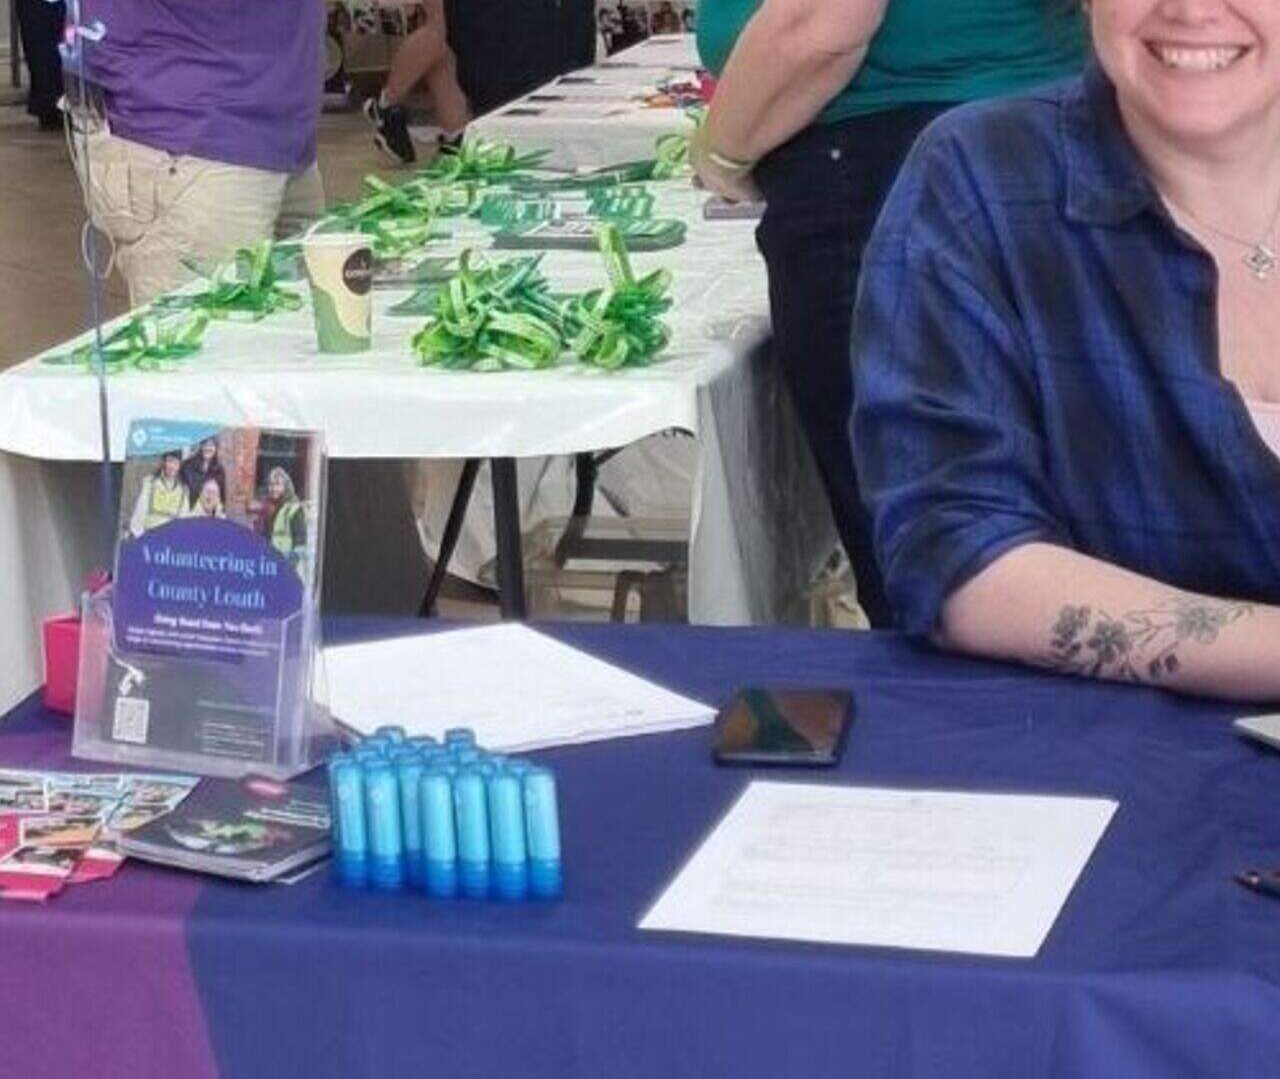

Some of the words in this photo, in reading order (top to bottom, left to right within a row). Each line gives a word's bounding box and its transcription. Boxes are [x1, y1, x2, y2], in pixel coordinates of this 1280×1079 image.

[142, 545, 257, 579] Volunteering
[260, 556, 278, 576] in
[147, 579, 208, 608] County
[214, 586, 266, 610] Louth
